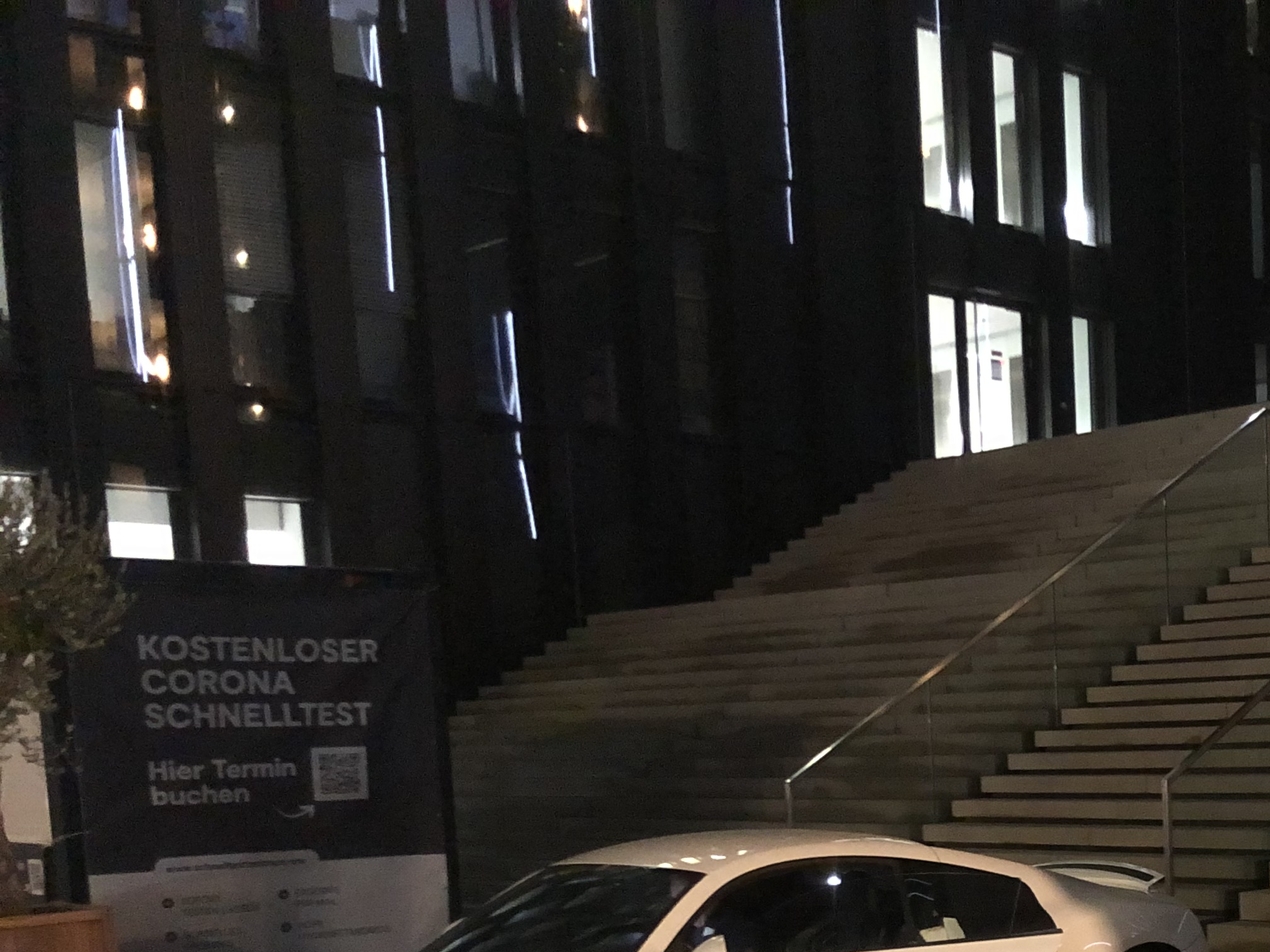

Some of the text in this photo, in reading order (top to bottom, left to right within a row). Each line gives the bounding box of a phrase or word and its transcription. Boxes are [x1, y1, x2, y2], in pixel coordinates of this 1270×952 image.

[137, 635, 378, 662] KOSTENLOSER
[140, 669, 295, 695] CORONA
[144, 702, 372, 728] SCHNELLTEST
[148, 757, 296, 781] Hier Termin
[150, 785, 250, 806] buchen
